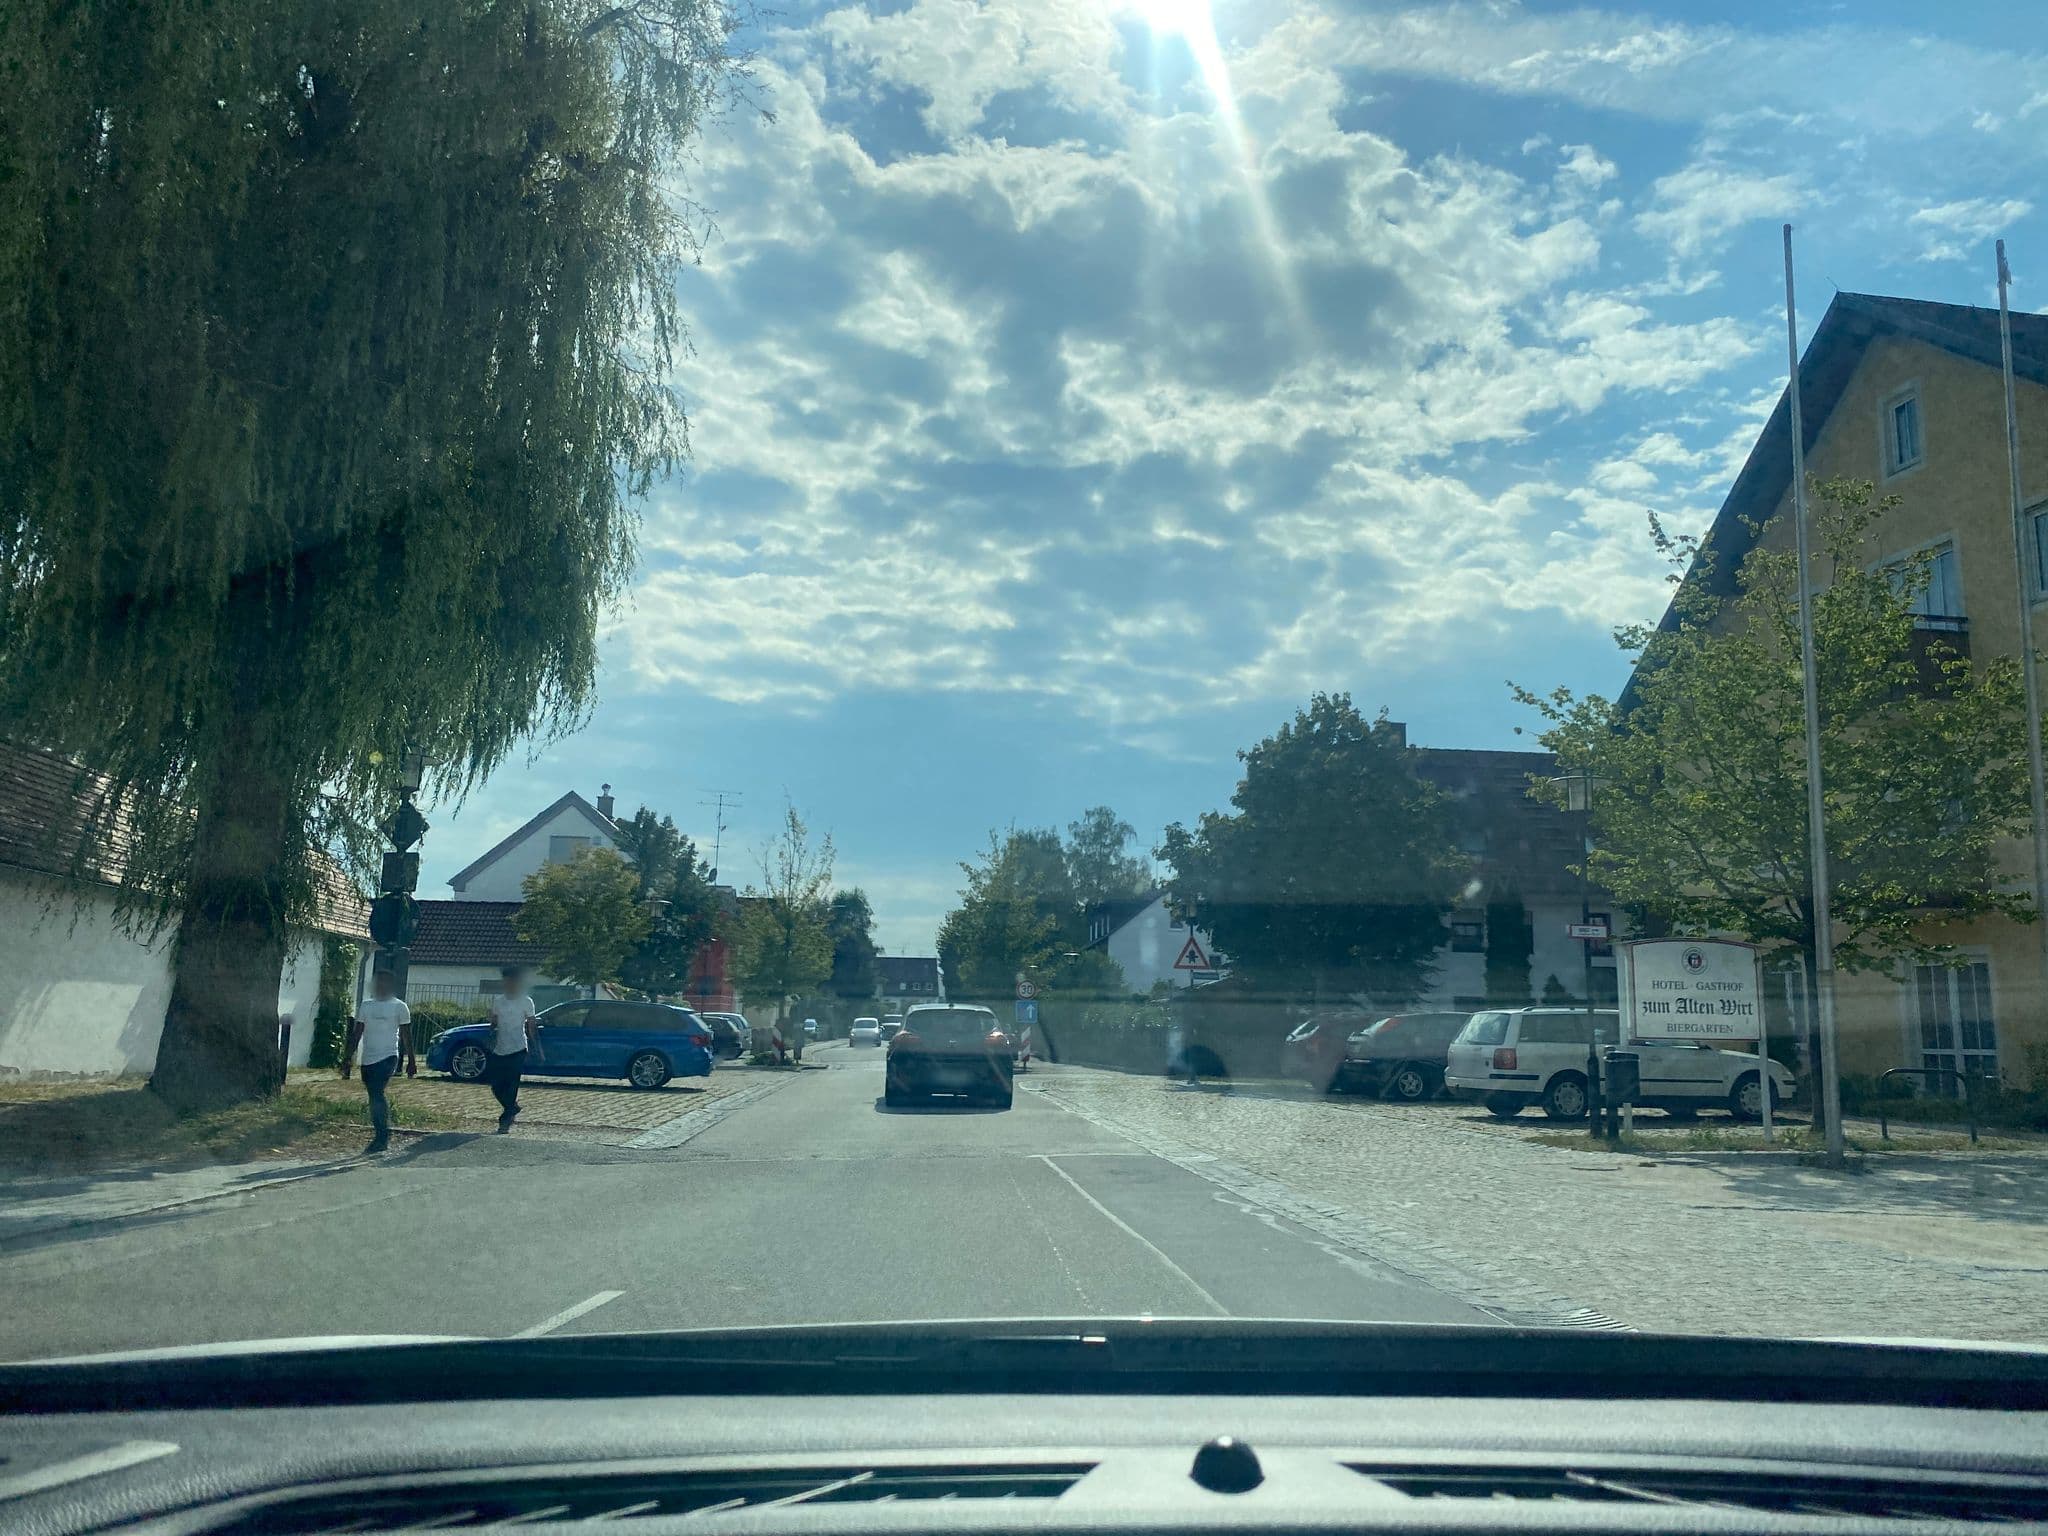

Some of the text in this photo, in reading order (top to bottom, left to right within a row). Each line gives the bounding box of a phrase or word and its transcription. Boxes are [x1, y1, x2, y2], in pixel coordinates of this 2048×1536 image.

[1021, 985, 1032, 994] 30
[1652, 980, 1744, 992] HOTEL GASTHOF
[1642, 998, 1753, 1016] zum Alten Wirt
[1667, 1023, 1733, 1034] BIERGARTEN
